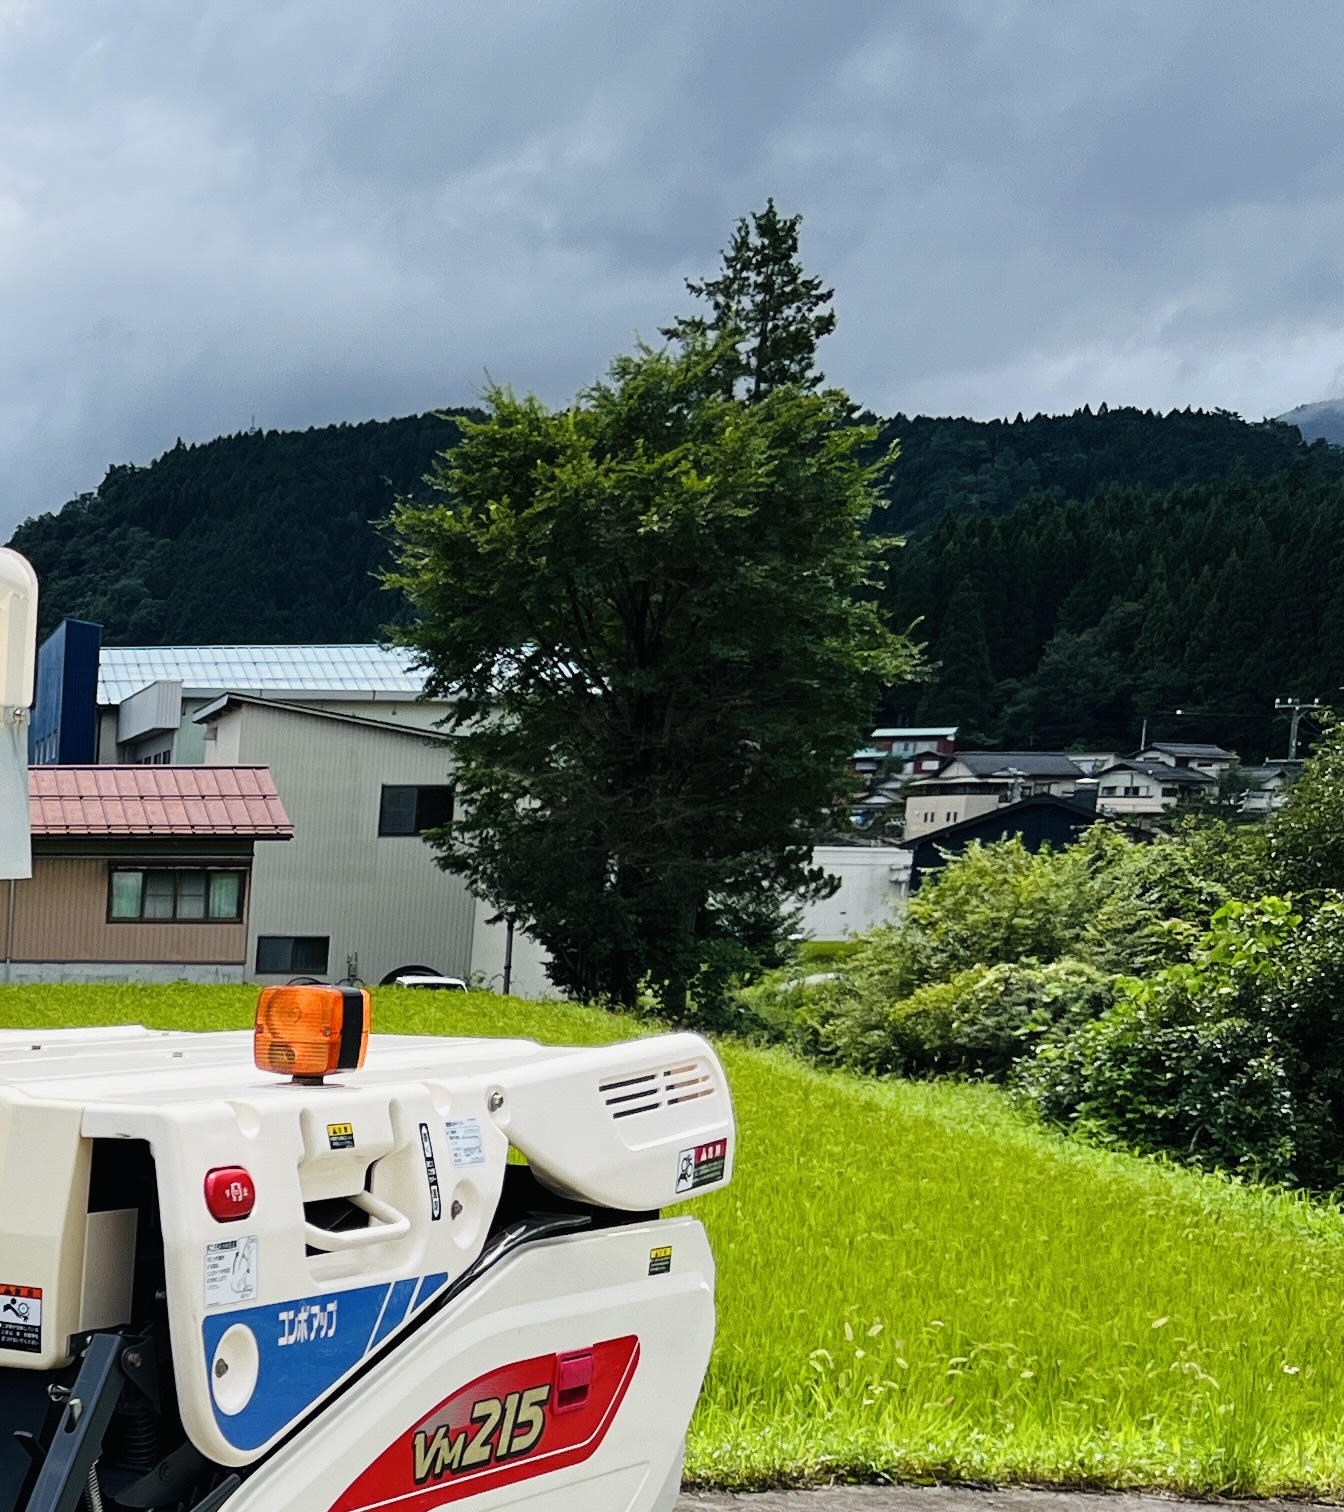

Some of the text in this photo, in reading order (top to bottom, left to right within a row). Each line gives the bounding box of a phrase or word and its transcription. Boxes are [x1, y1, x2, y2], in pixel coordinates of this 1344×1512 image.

[278, 1299, 337, 1347] コンボアップ
